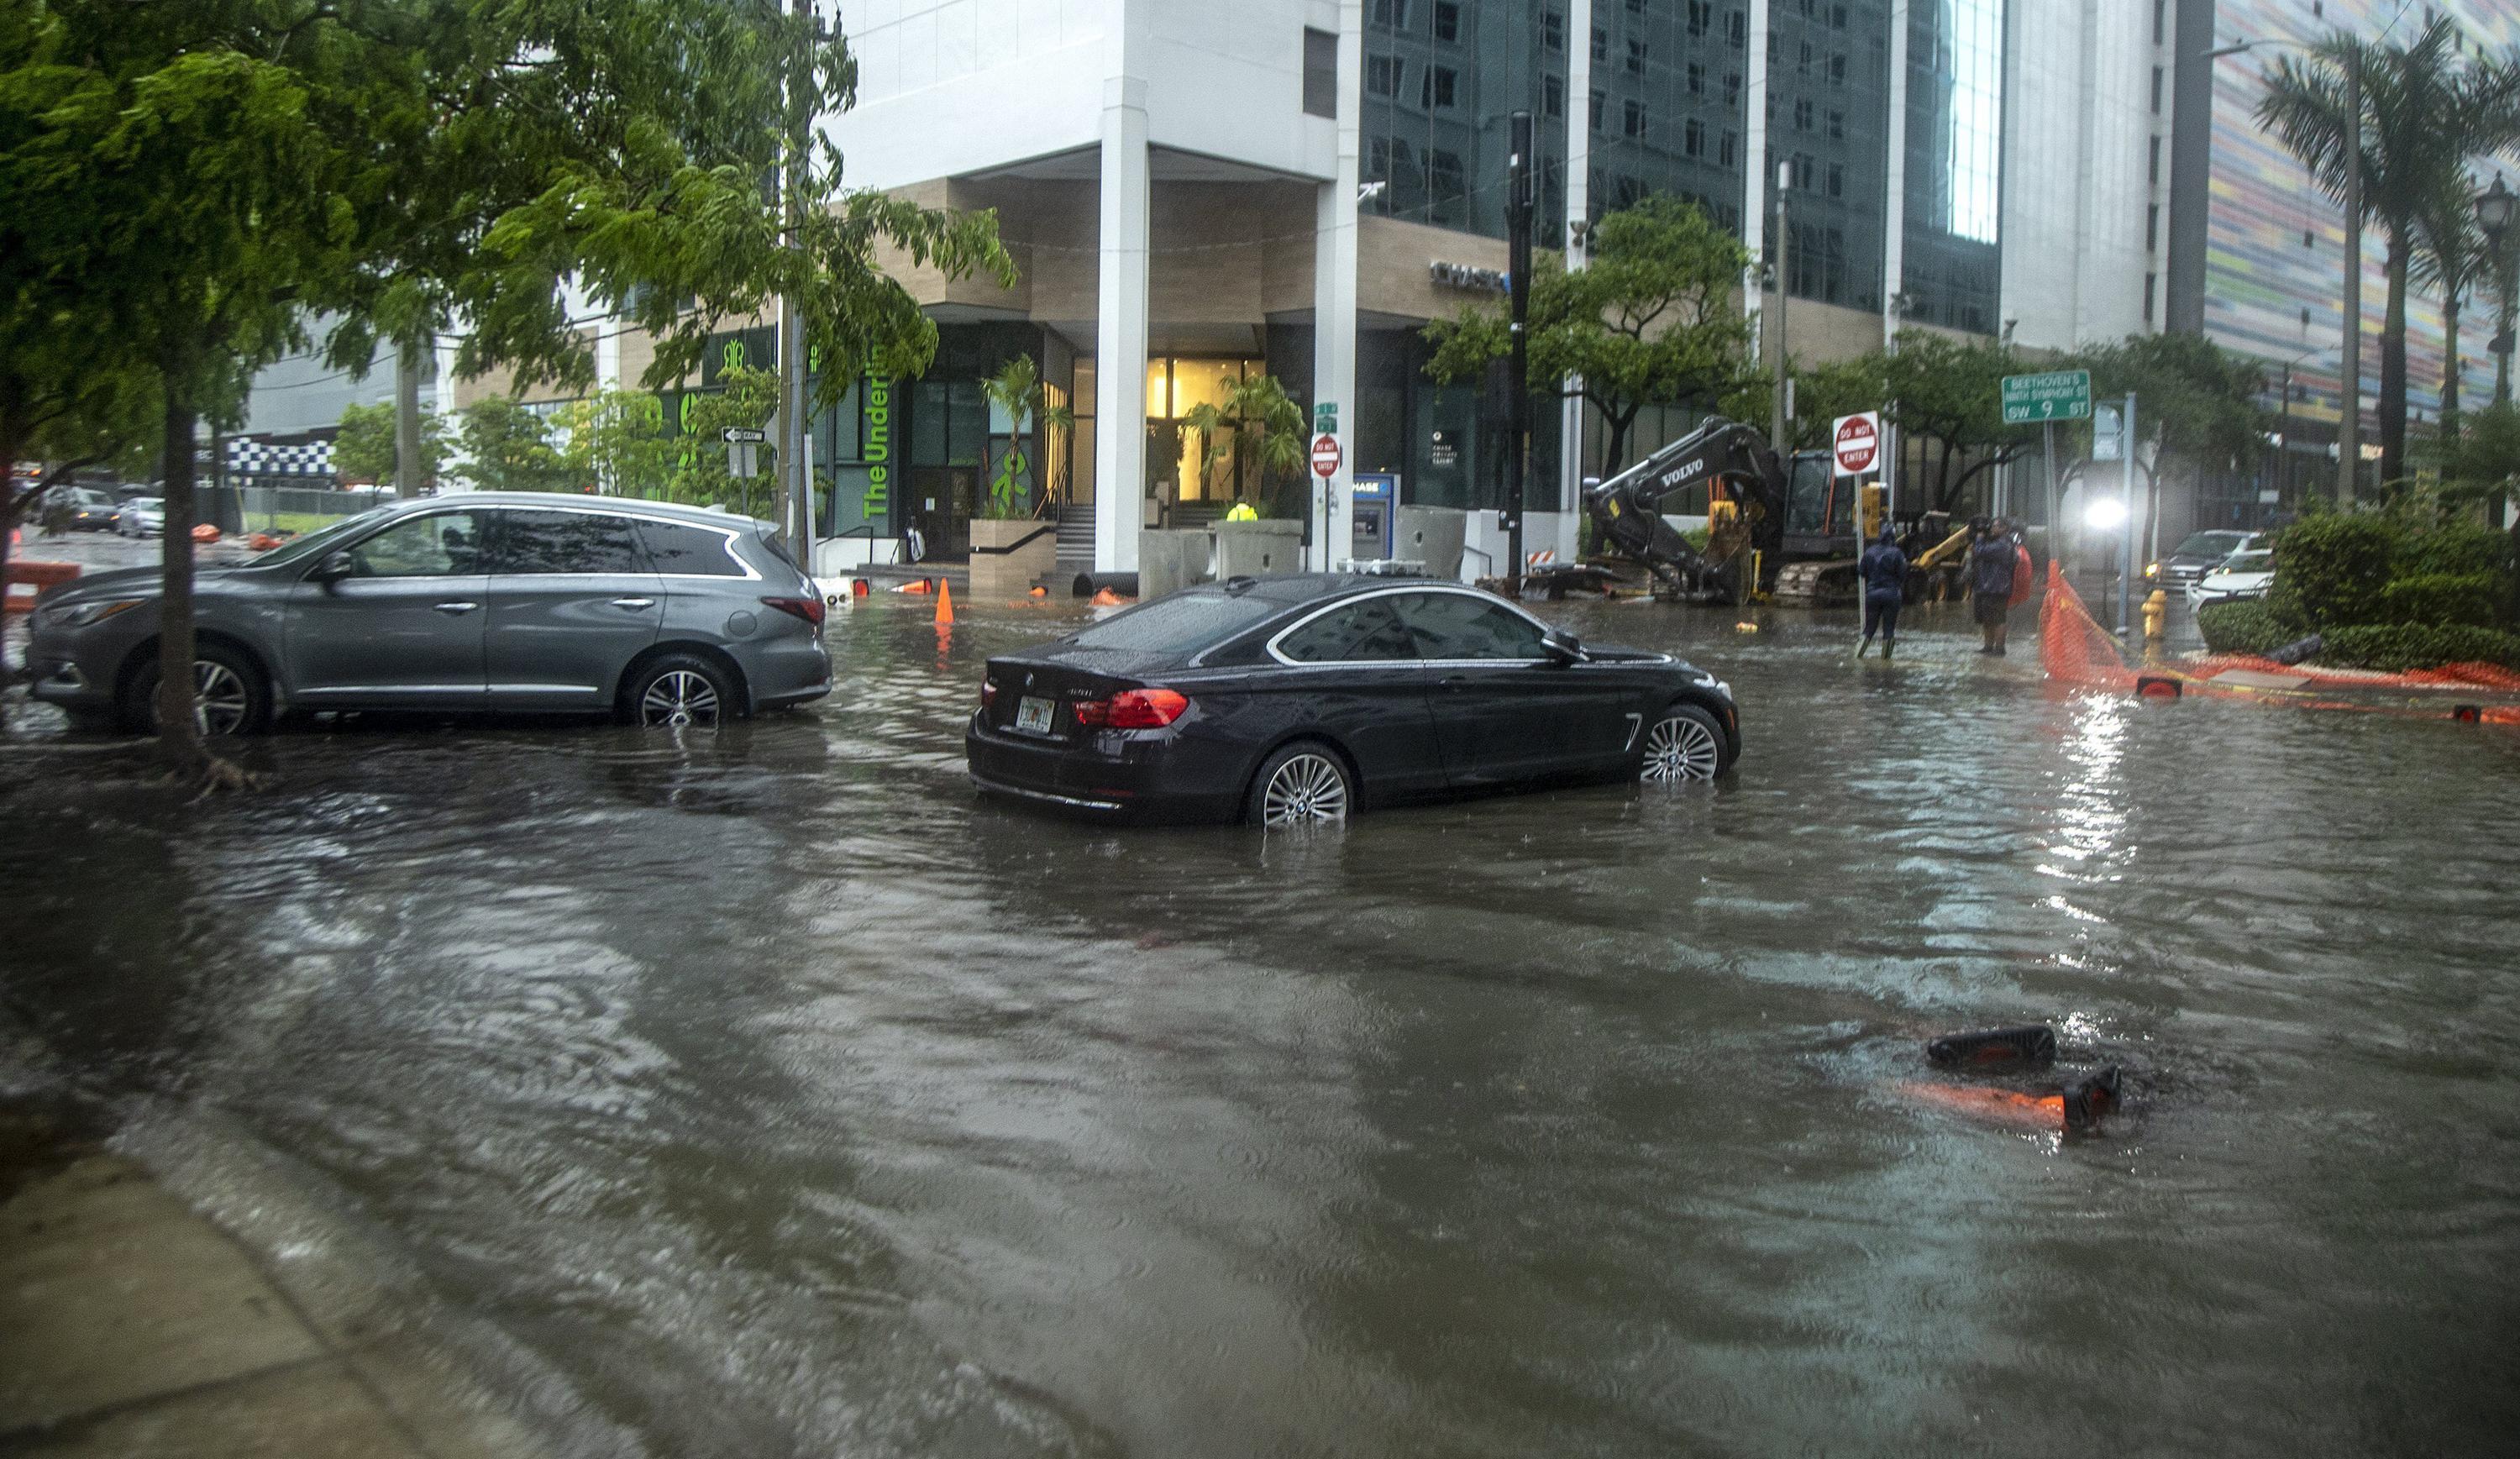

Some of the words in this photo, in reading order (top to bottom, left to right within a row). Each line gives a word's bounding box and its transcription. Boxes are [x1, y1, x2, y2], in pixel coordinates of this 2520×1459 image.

[1430, 261, 1504, 290] CHASE
[864, 343, 888, 462] Underlin
[2008, 406, 2030, 418] SW
[2042, 401, 2053, 418] 9
[2069, 401, 2087, 417] ST
[1840, 427, 1851, 440] DO
[1855, 424, 1870, 438] NOT
[1316, 443, 1324, 451] DO
[1325, 443, 1335, 451] NOT
[1844, 450, 1869, 464] ENTER
[1317, 462, 1333, 471] ENTER
[1662, 458, 1704, 486] VOLVO
[864, 465, 887, 520] The
[1352, 482, 1379, 492] HASE
